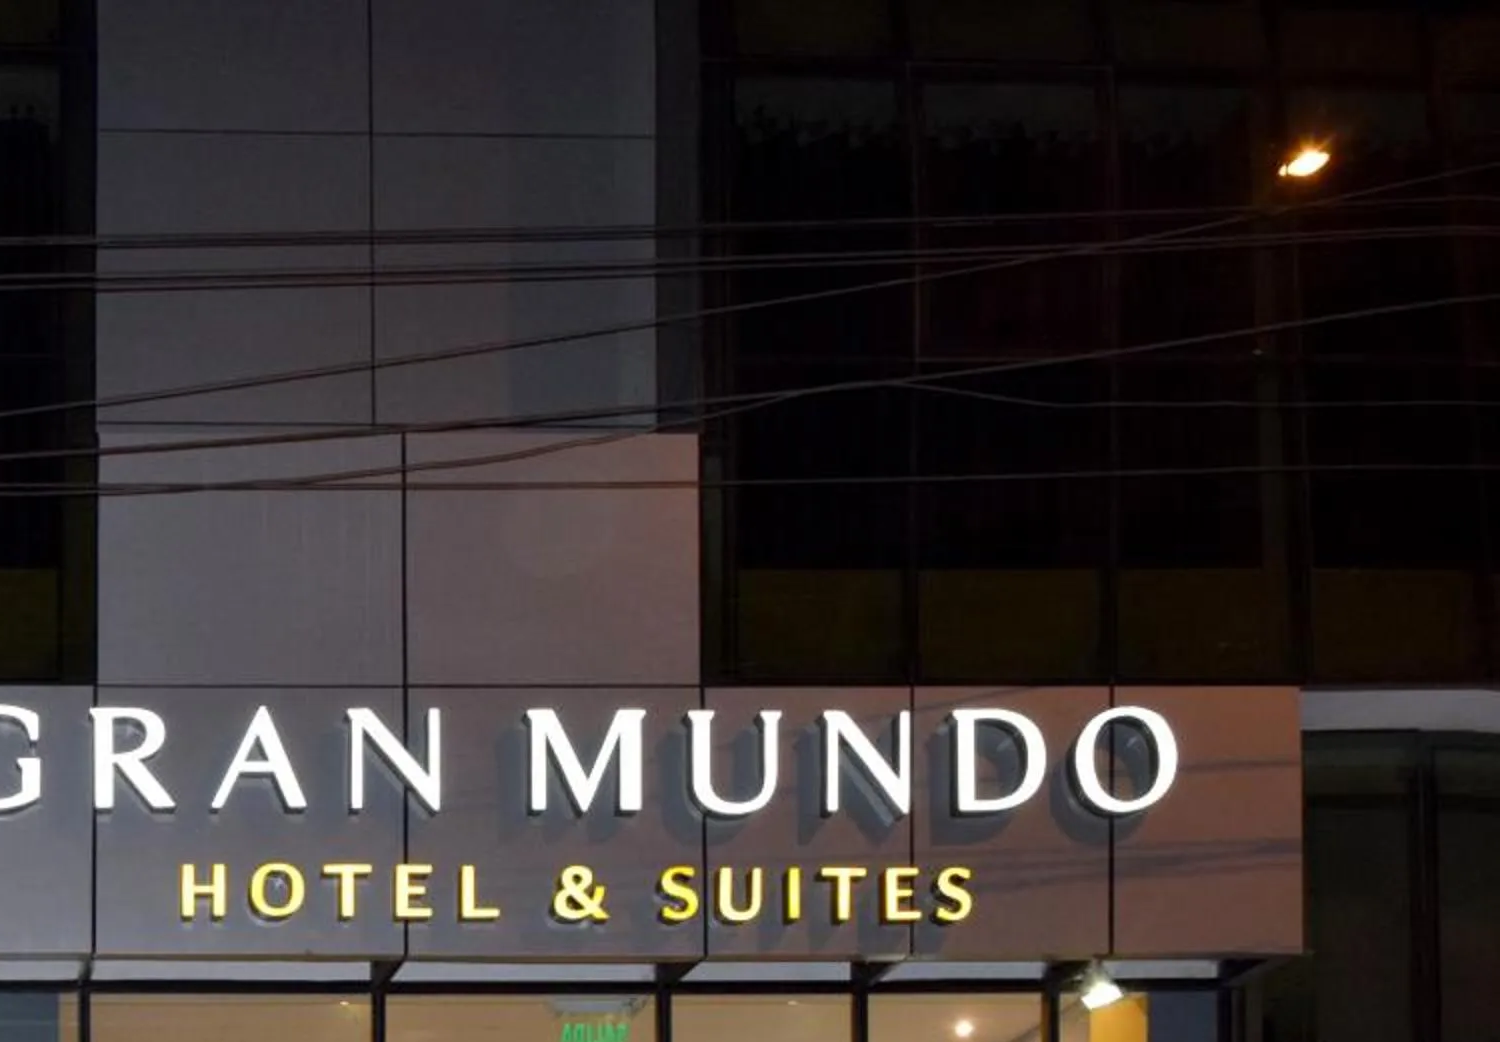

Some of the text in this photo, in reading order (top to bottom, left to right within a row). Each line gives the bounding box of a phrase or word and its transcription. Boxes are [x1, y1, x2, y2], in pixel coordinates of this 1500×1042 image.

[528, 705, 1179, 815] MUNDO
[181, 862, 974, 923] HOTEL & SUITES
